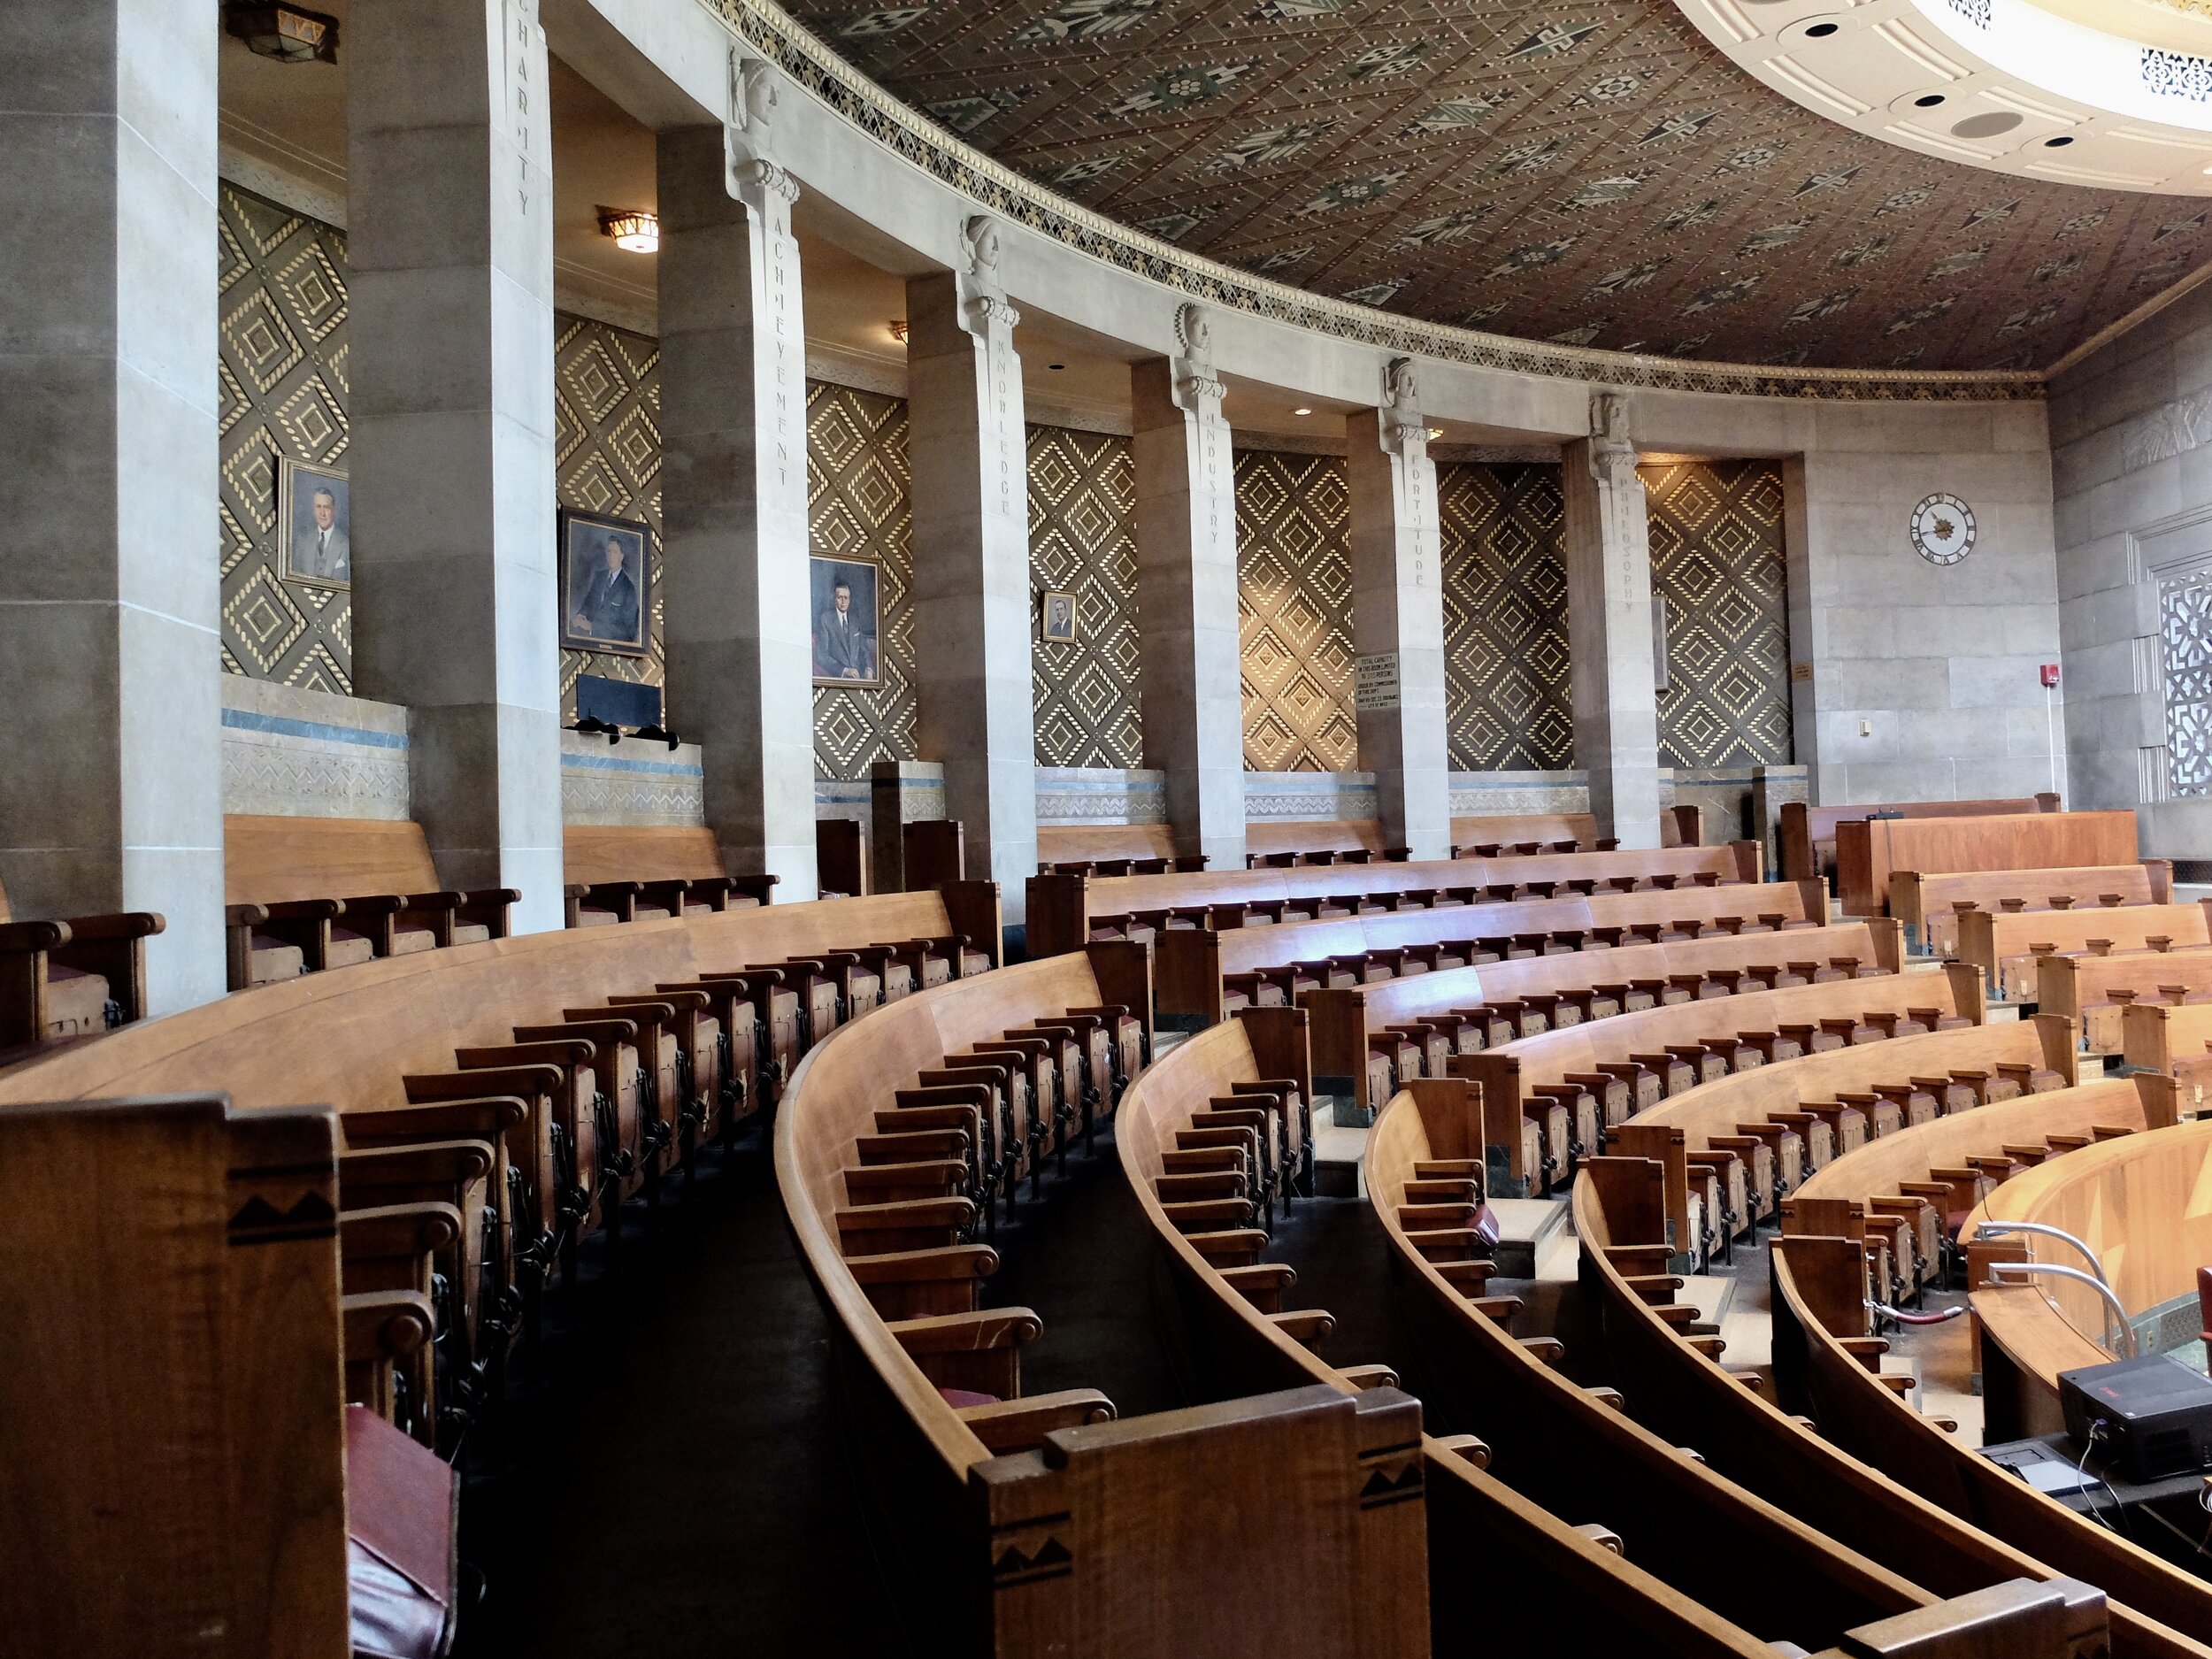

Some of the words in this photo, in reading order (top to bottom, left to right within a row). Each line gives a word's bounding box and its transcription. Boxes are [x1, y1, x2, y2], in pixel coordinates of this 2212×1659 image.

[996, 339, 1010, 517] KNOWLEDGE
[1205, 412, 1218, 544] INDUSTRY
[1411, 454, 1424, 586] FORTITUDE
[1619, 478, 1633, 612] PHILOSOPHY
